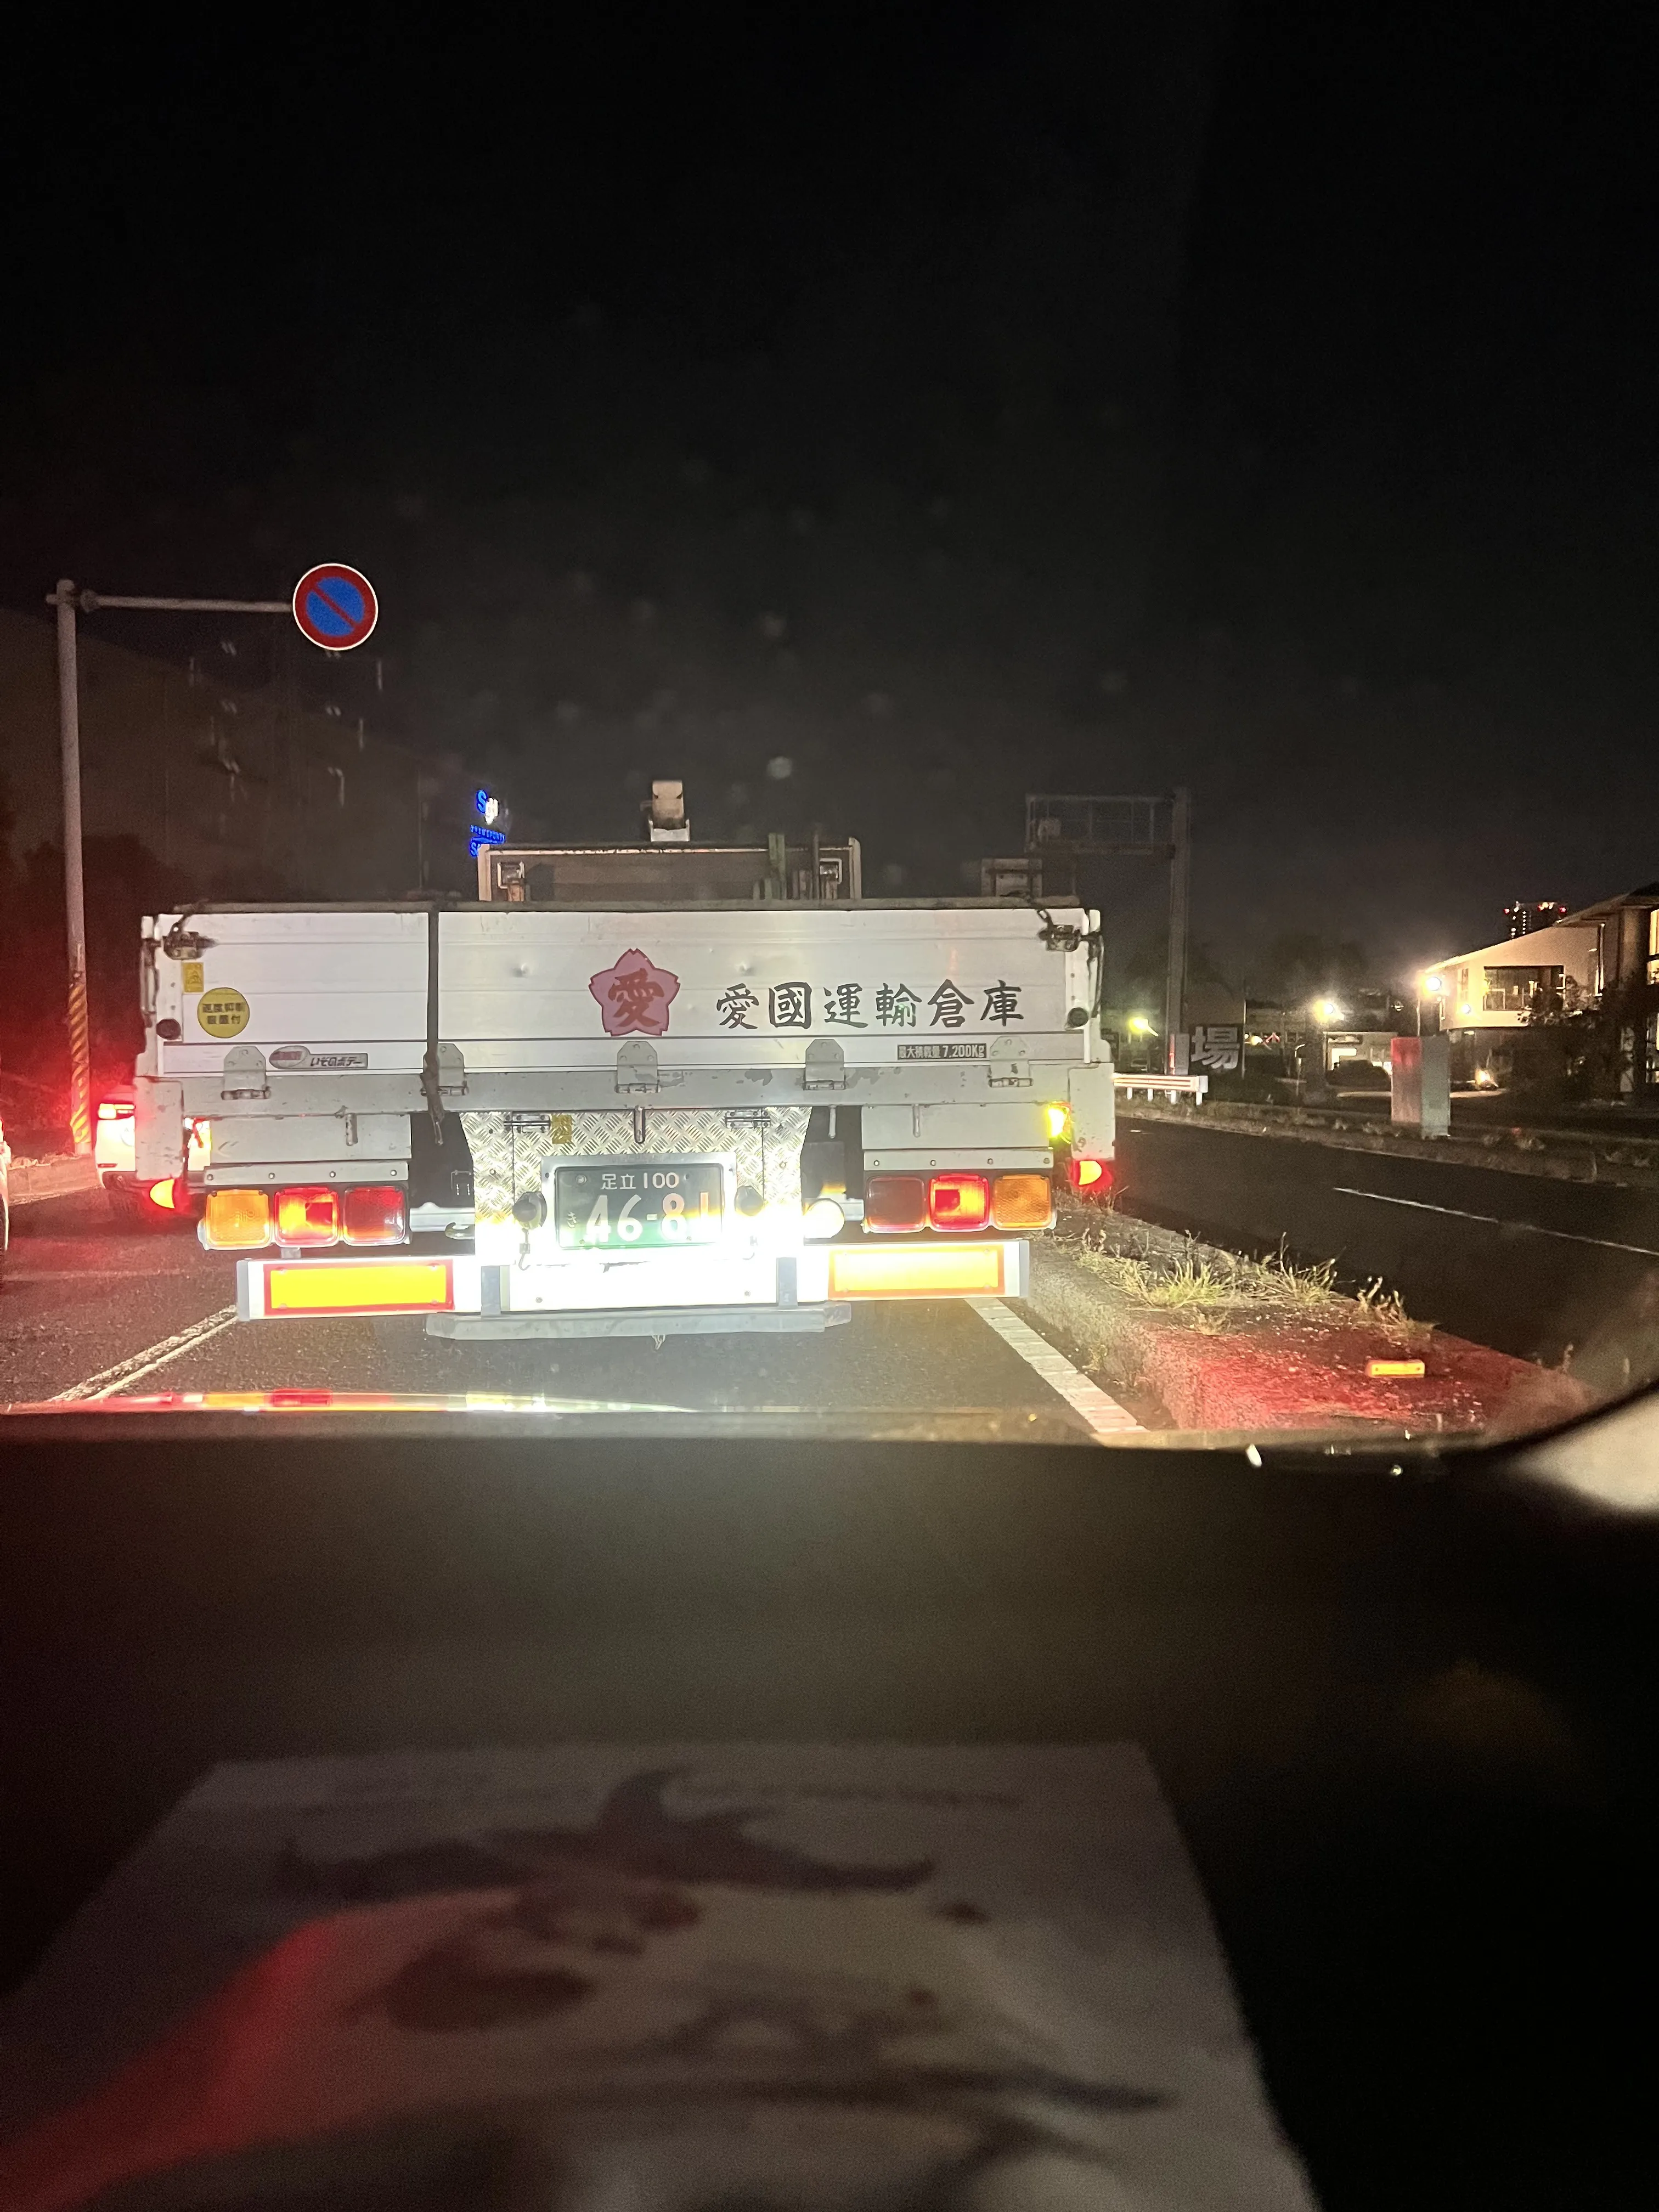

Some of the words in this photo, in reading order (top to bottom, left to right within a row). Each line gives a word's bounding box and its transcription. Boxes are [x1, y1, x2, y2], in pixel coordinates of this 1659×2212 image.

[608, 968, 665, 1028] 愛
[716, 979, 1025, 1029] 愛國運輸倉庫
[1190, 1026, 1240, 1069] 場
[600, 1173, 636, 1190] 足立
[644, 1172, 680, 1189] 100
[566, 1211, 577, 1228] き
[585, 1192, 709, 1243] 46-81
